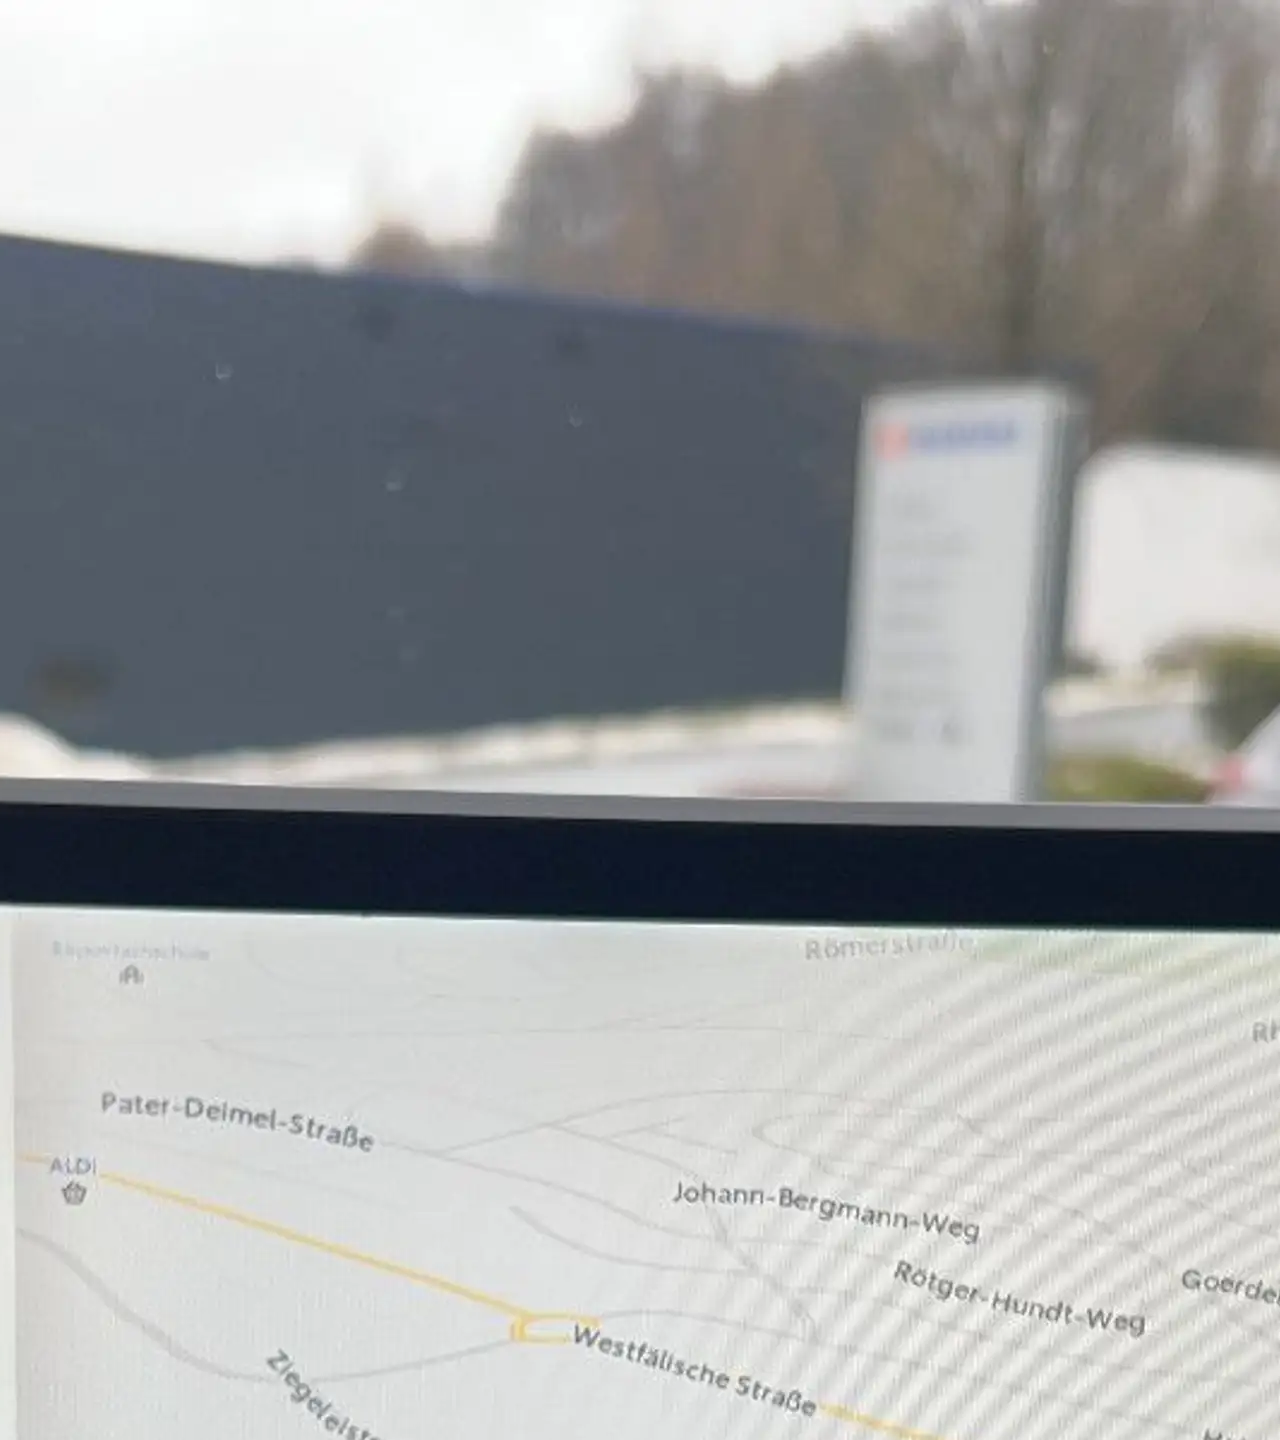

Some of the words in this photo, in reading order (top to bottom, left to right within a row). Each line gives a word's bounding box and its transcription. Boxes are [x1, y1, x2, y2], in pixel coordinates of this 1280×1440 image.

[101, 1091, 376, 1153] Pater-Deimel-Straße
[49, 1157, 98, 1175] ALDI
[672, 1181, 980, 1245] Johann-Bergmann-Weg
[893, 1259, 1147, 1337] Rötger-Hundt-Weg
[574, 1323, 730, 1390] Westfälische
[735, 1374, 817, 1418] Straße
